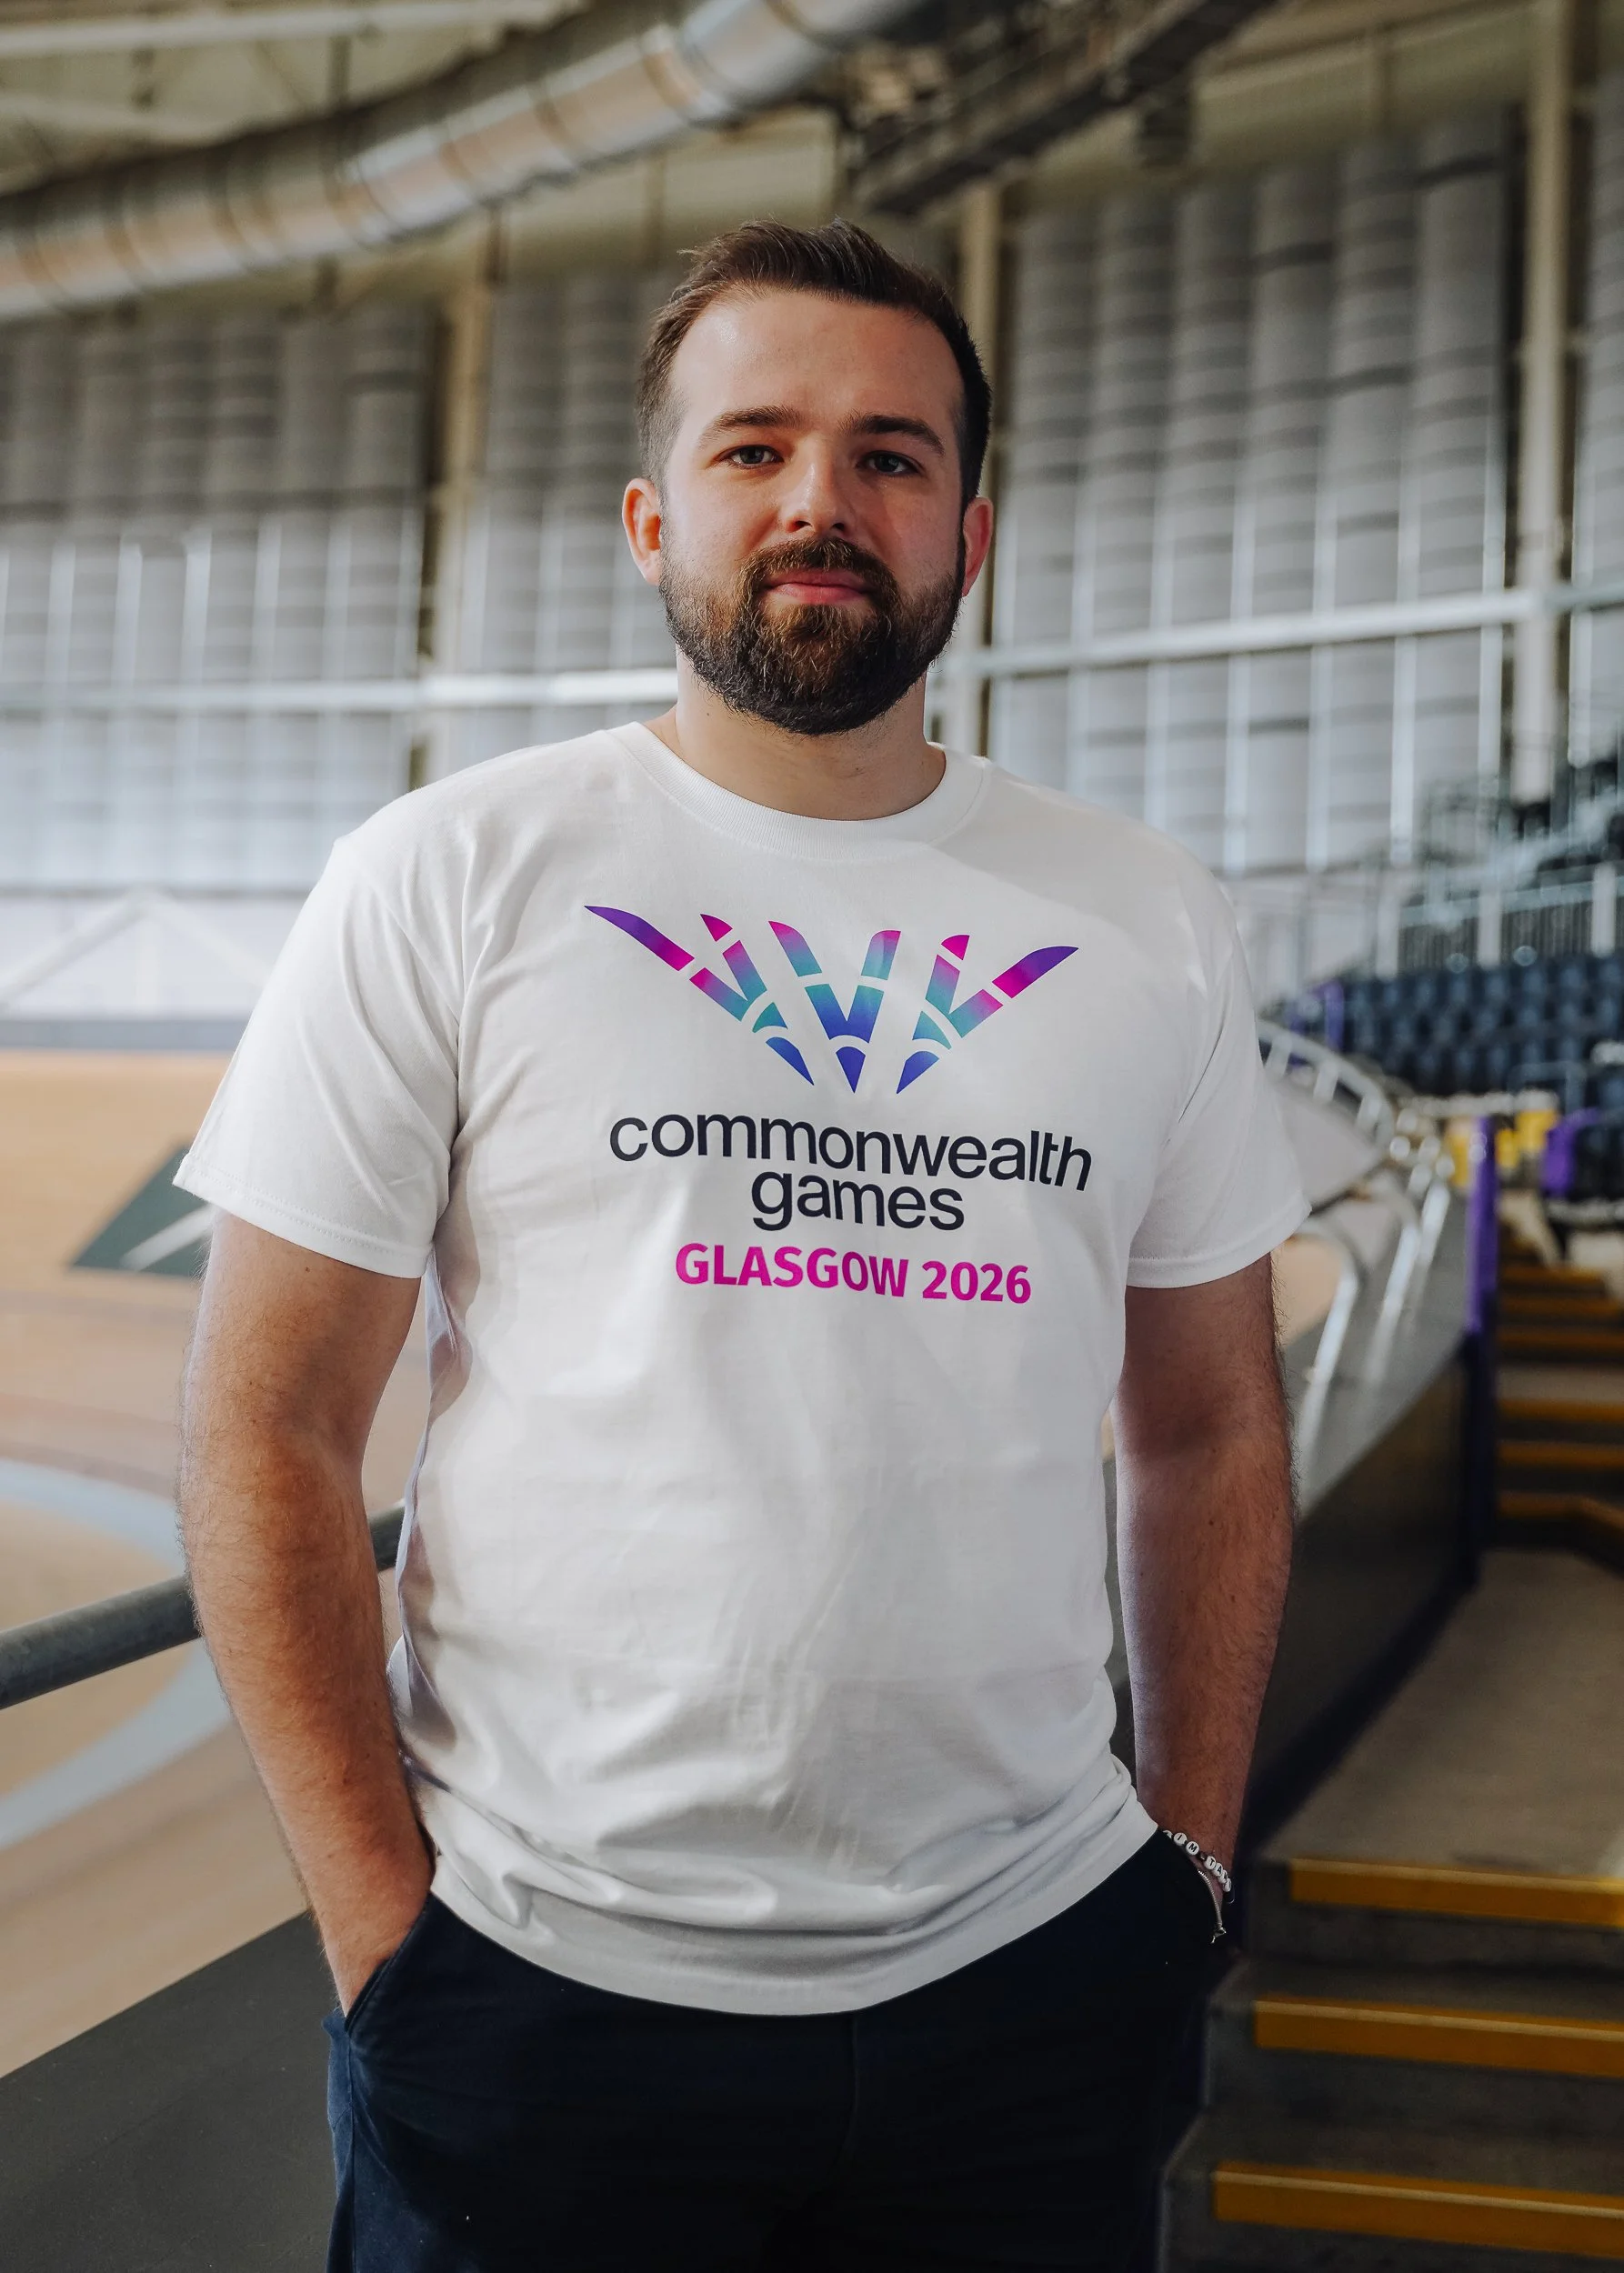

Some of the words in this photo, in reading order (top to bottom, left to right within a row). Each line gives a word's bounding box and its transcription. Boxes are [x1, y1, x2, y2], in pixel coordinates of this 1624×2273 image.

[609, 1114, 1092, 1192] commonwealth
[751, 1171, 965, 1232] games
[676, 1242, 909, 1298] GLASGOW
[921, 1260, 1032, 1304] 2026
